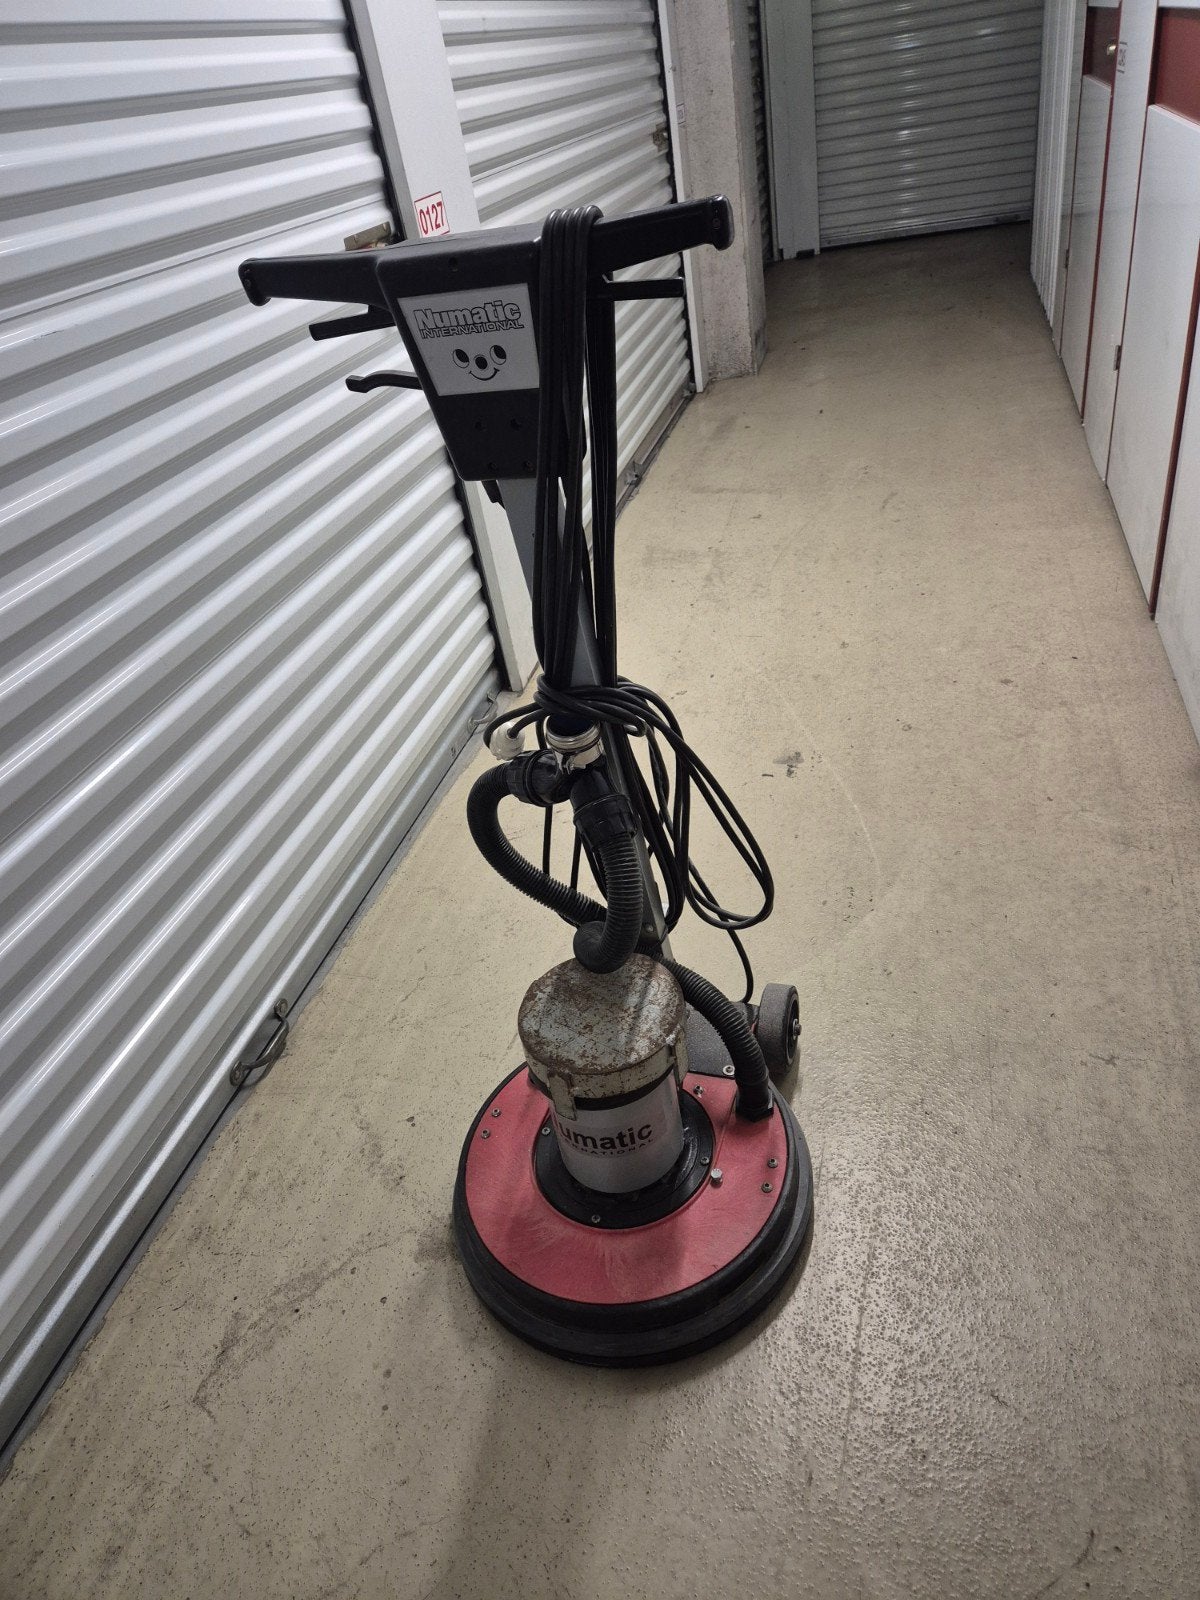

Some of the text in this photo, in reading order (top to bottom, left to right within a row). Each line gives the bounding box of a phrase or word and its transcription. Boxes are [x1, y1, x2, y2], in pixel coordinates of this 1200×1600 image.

[419, 201, 445, 235] 0127
[413, 300, 522, 330] Numatic
[420, 319, 525, 339] INTERNATIONAL
[558, 1122, 653, 1150] umatic
